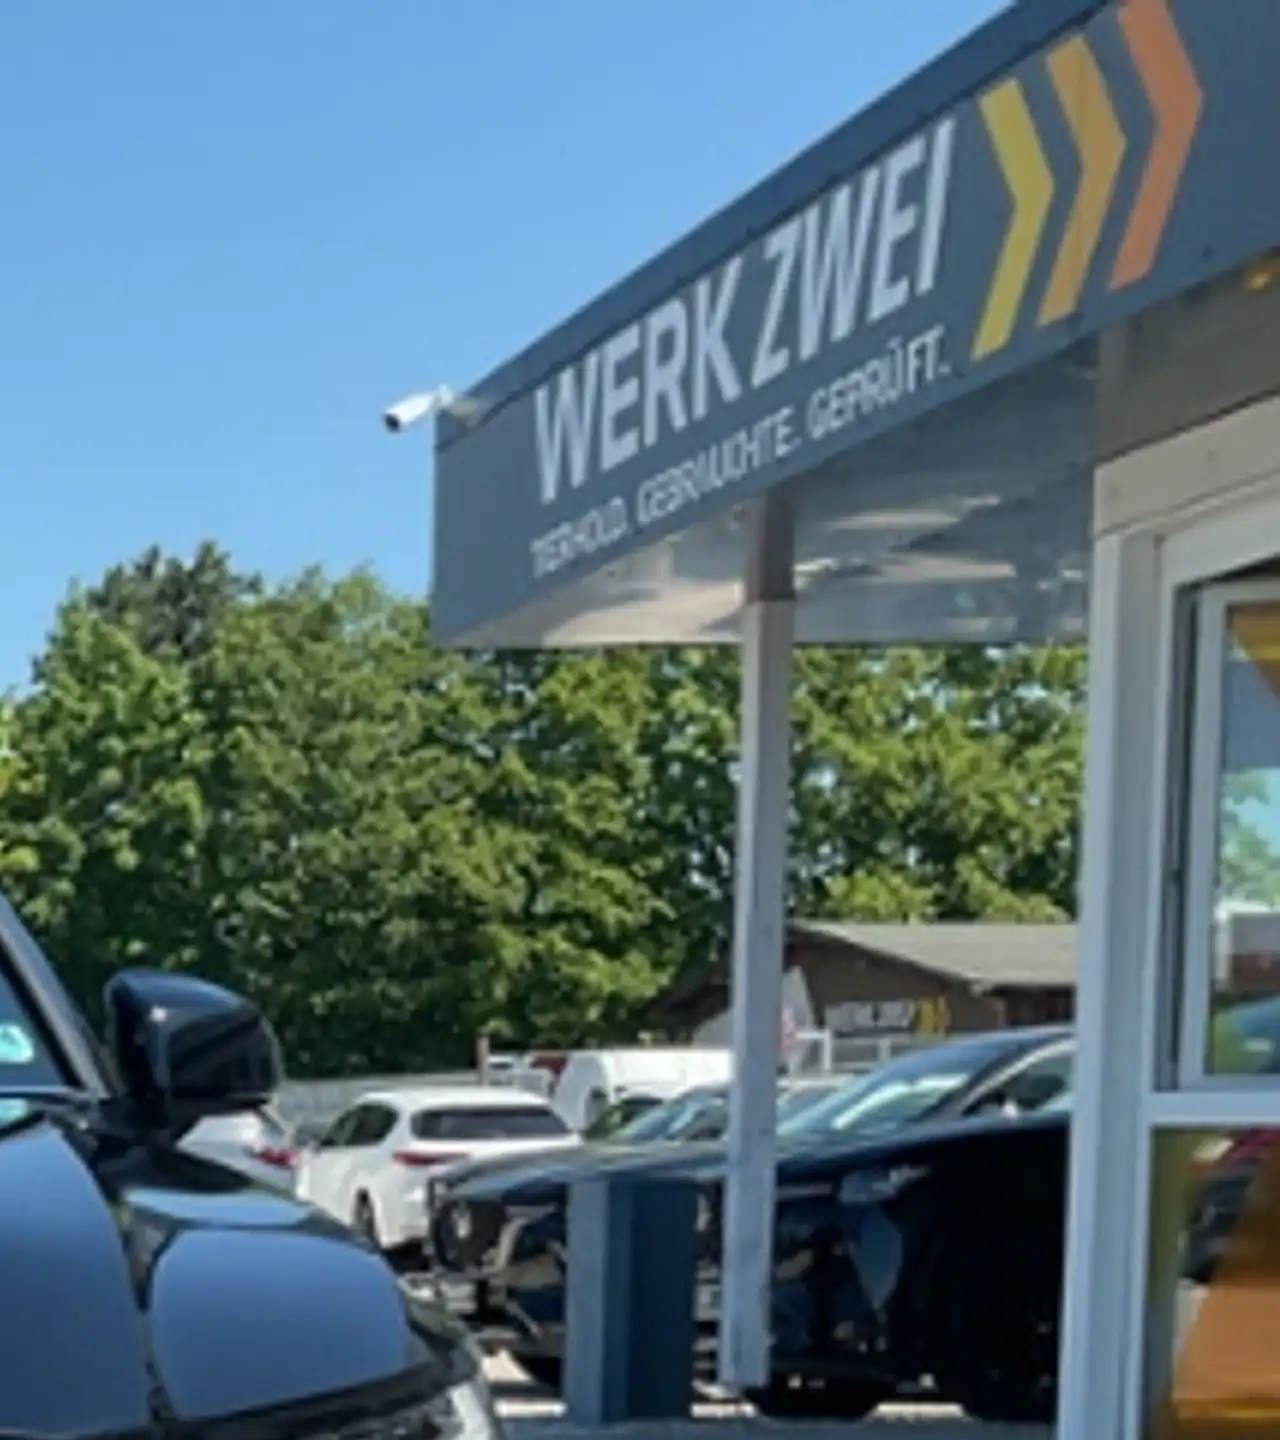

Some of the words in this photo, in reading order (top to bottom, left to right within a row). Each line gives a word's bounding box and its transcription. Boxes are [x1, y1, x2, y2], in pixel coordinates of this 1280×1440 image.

[534, 258, 745, 505] WERK
[751, 118, 954, 392] ZWEI
[807, 323, 952, 441] GEPRÜFT.
